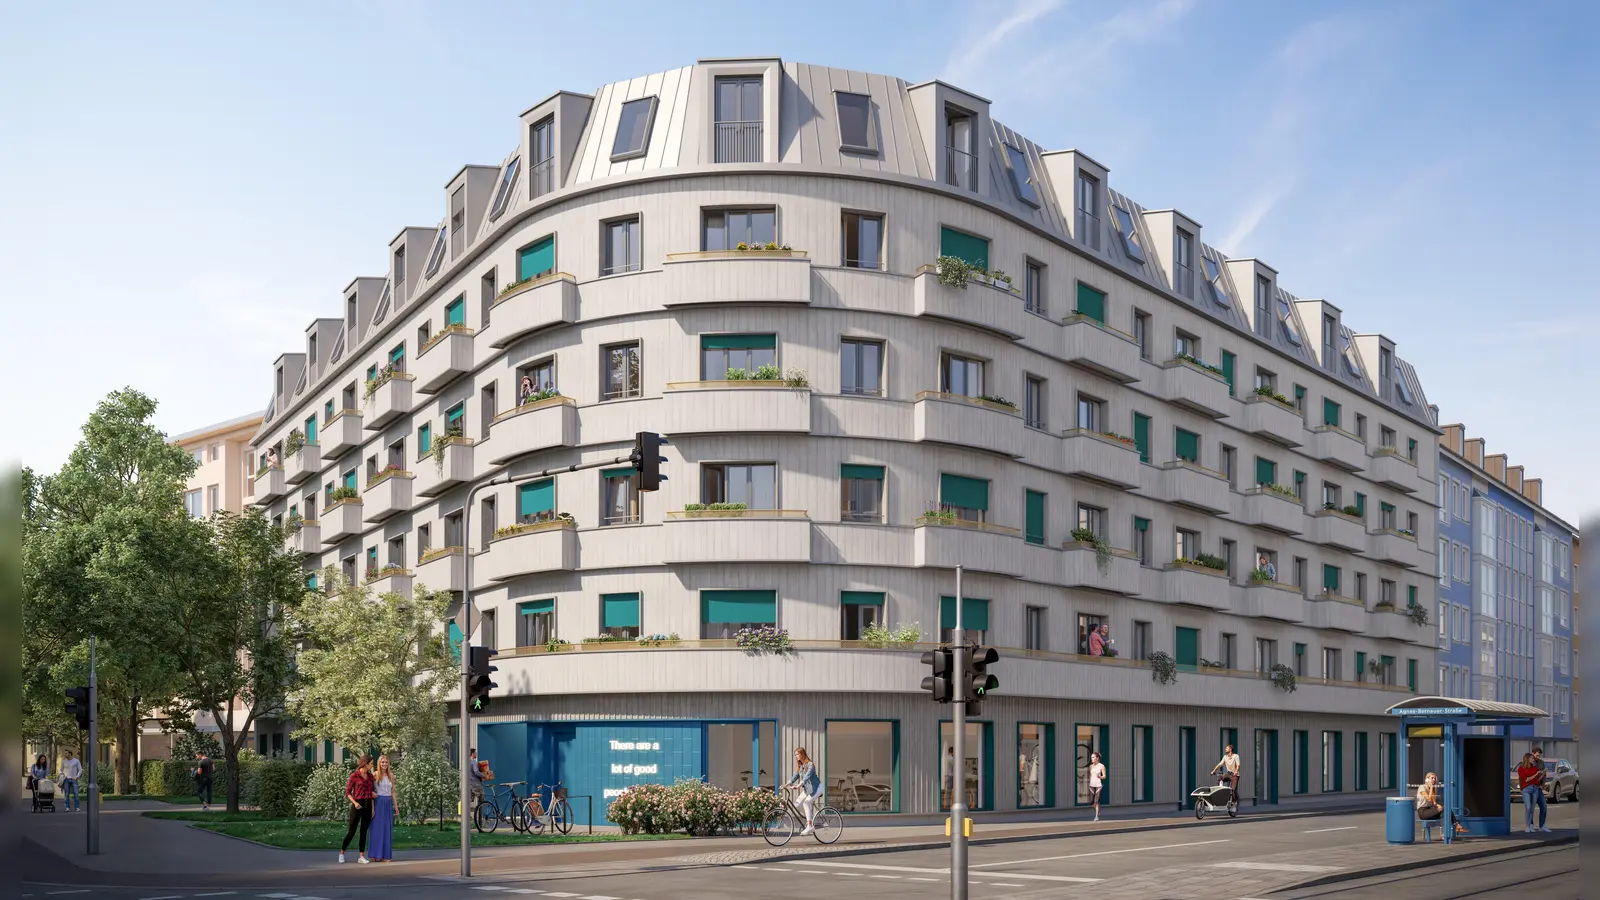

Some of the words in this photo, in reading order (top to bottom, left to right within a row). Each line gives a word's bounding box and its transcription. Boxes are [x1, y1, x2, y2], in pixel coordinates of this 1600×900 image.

[609, 740, 635, 750] There
[636, 742, 651, 750] are
[652, 742, 660, 750] a
[611, 763, 623, 774] lot
[623, 763, 633, 774] of
[633, 763, 658, 776] good
